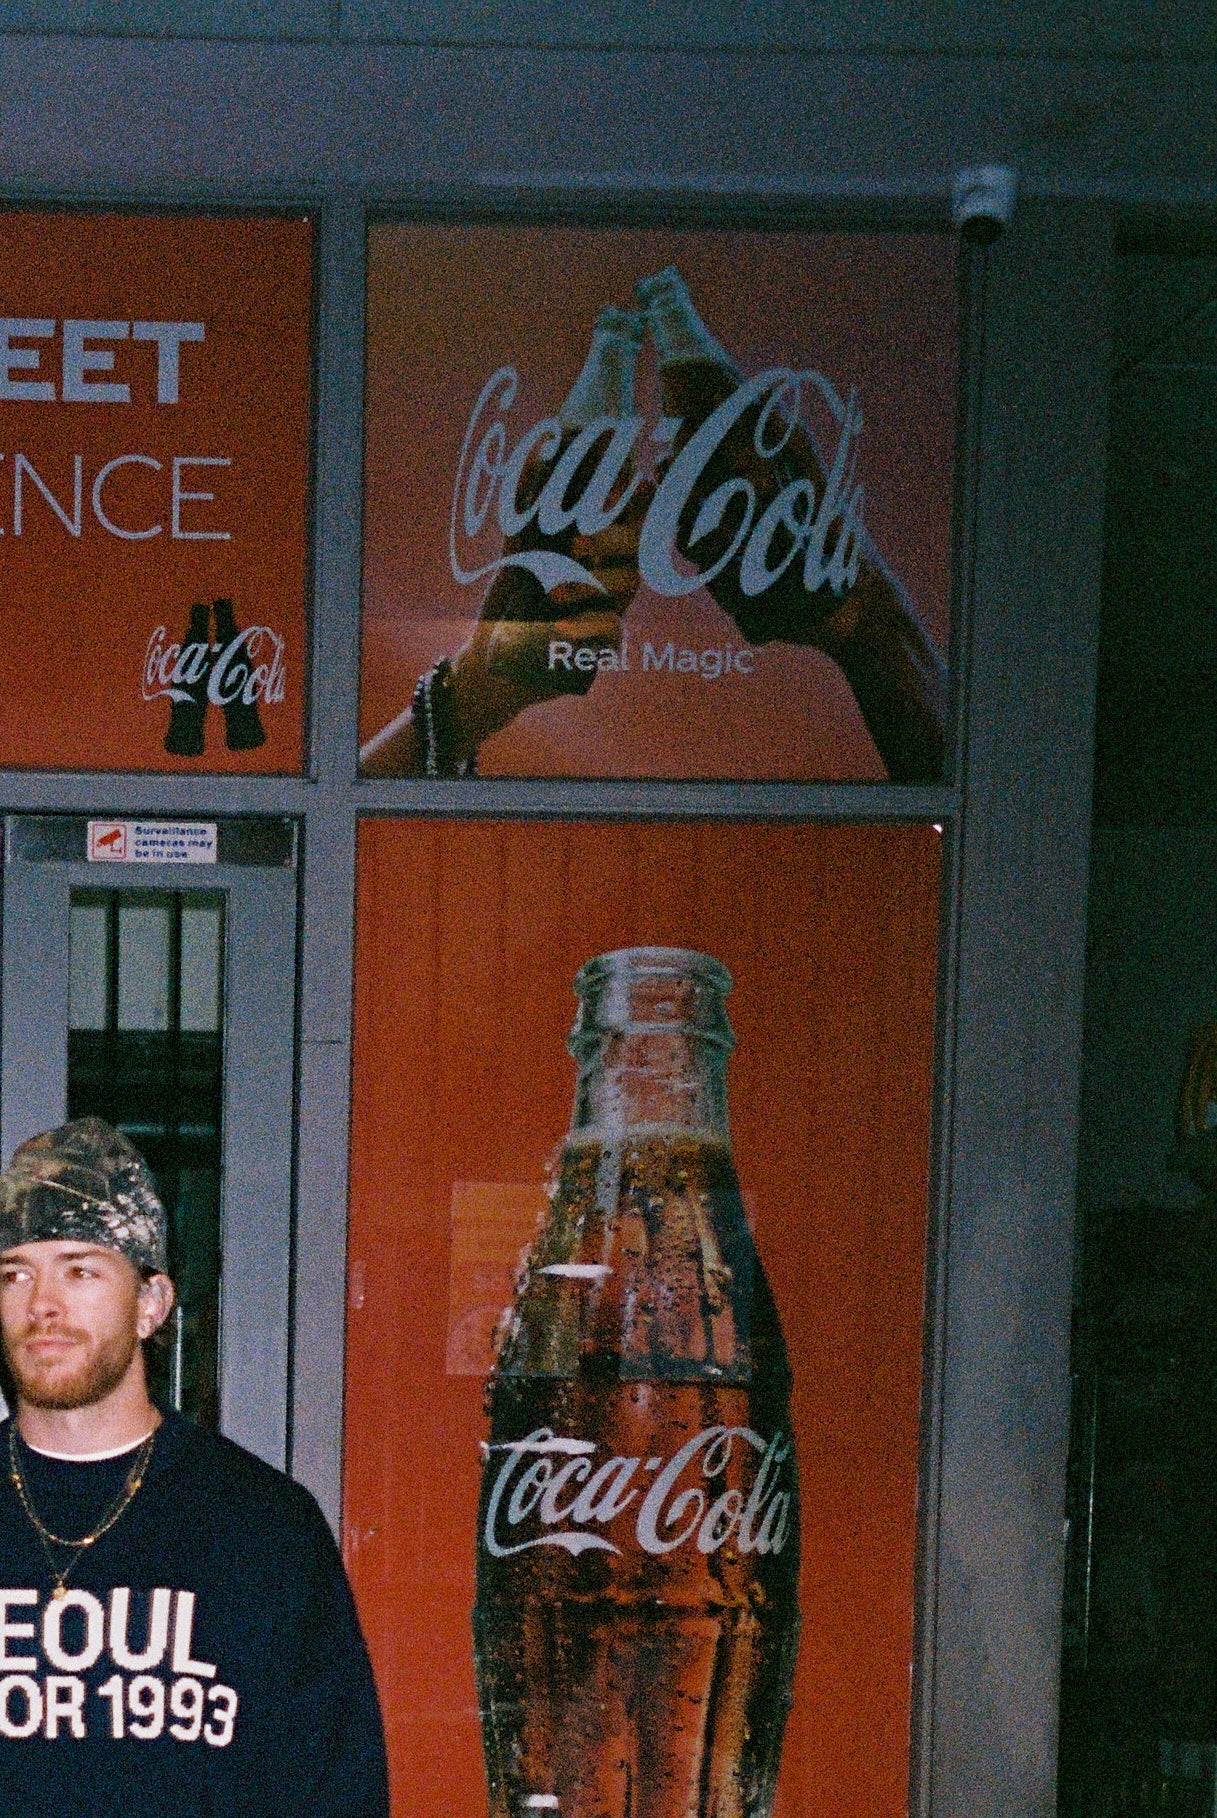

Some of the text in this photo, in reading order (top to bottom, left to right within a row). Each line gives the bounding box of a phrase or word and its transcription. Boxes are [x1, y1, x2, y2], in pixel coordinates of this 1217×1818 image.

[548, 641, 754, 679] Real Magic
[135, 849, 149, 858] be
[188, 840, 213, 849] may
[485, 1425, 792, 1557] Coca-Cola
[98, 1674, 239, 1747] 1993
